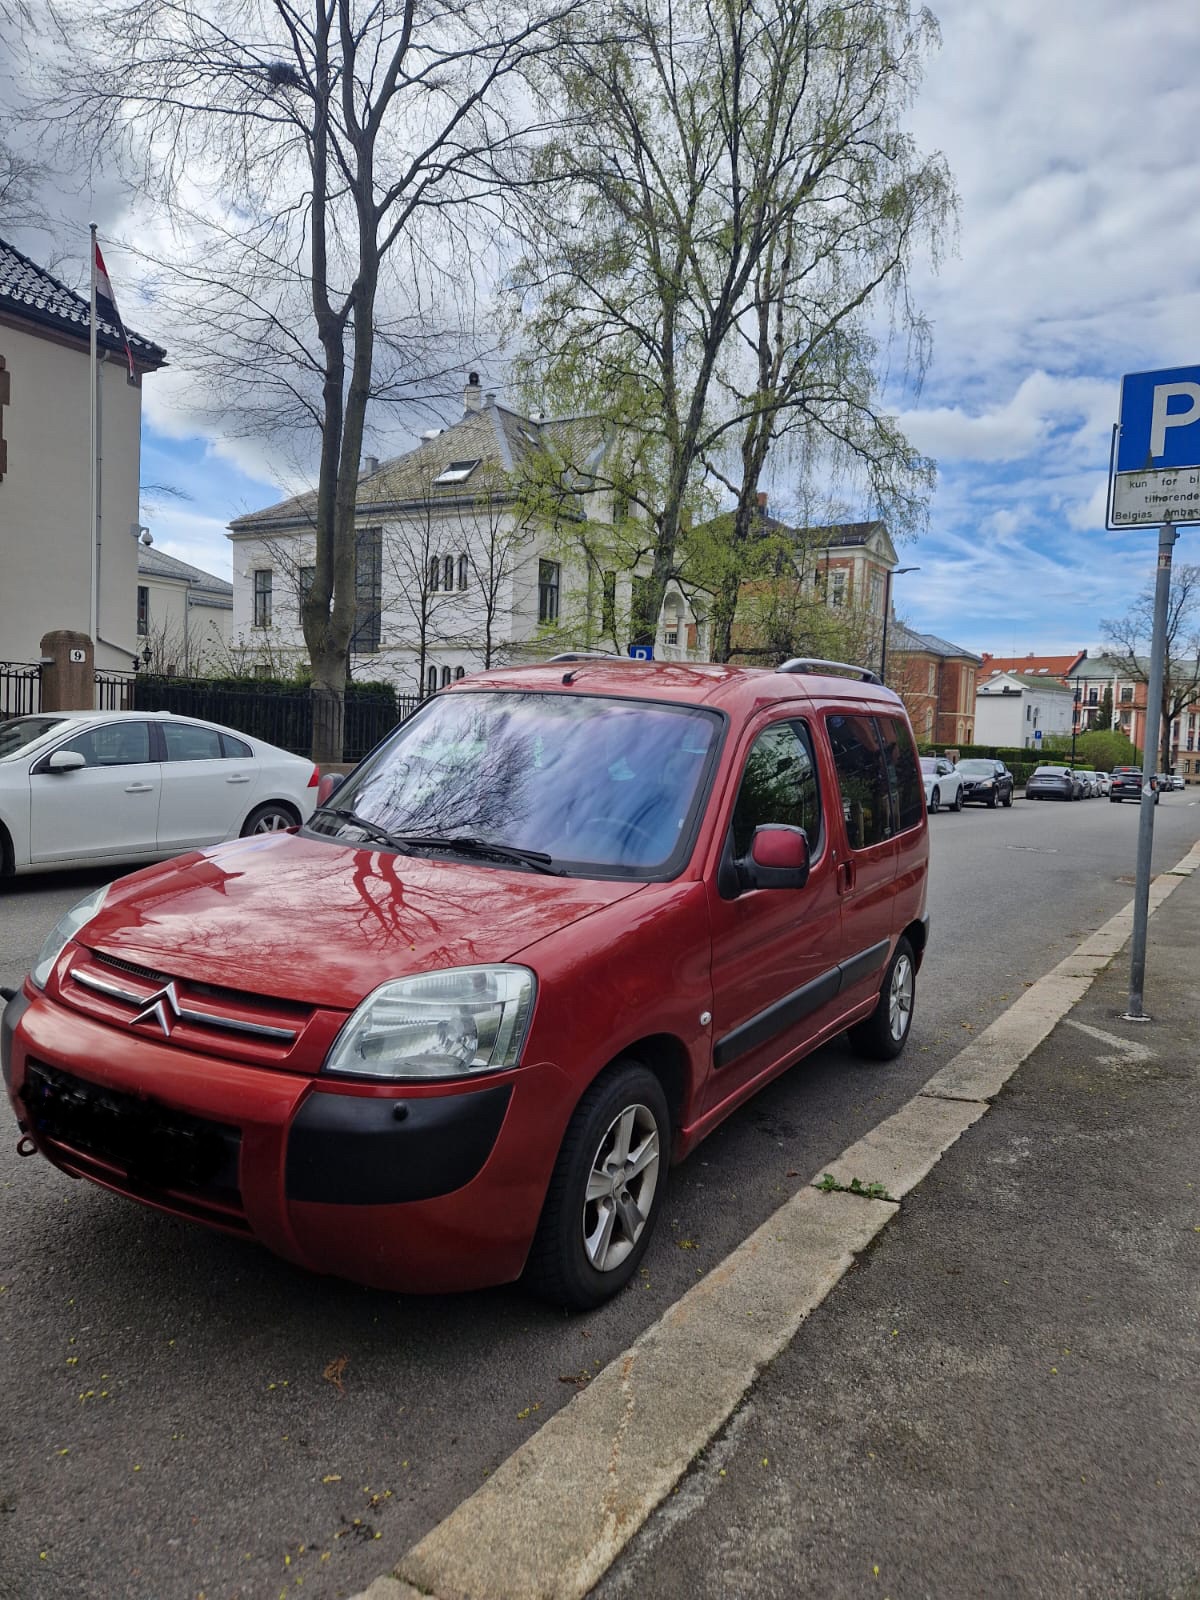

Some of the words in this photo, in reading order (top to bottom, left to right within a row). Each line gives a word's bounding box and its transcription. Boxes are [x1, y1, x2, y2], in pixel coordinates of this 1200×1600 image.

[1150, 381, 1200, 458] P
[1129, 480, 1148, 489] kun
[1162, 477, 1177, 486] for
[1115, 510, 1152, 522] Belgias
[1163, 506, 1200, 519] Ambas
[74, 650, 82, 661] 9
